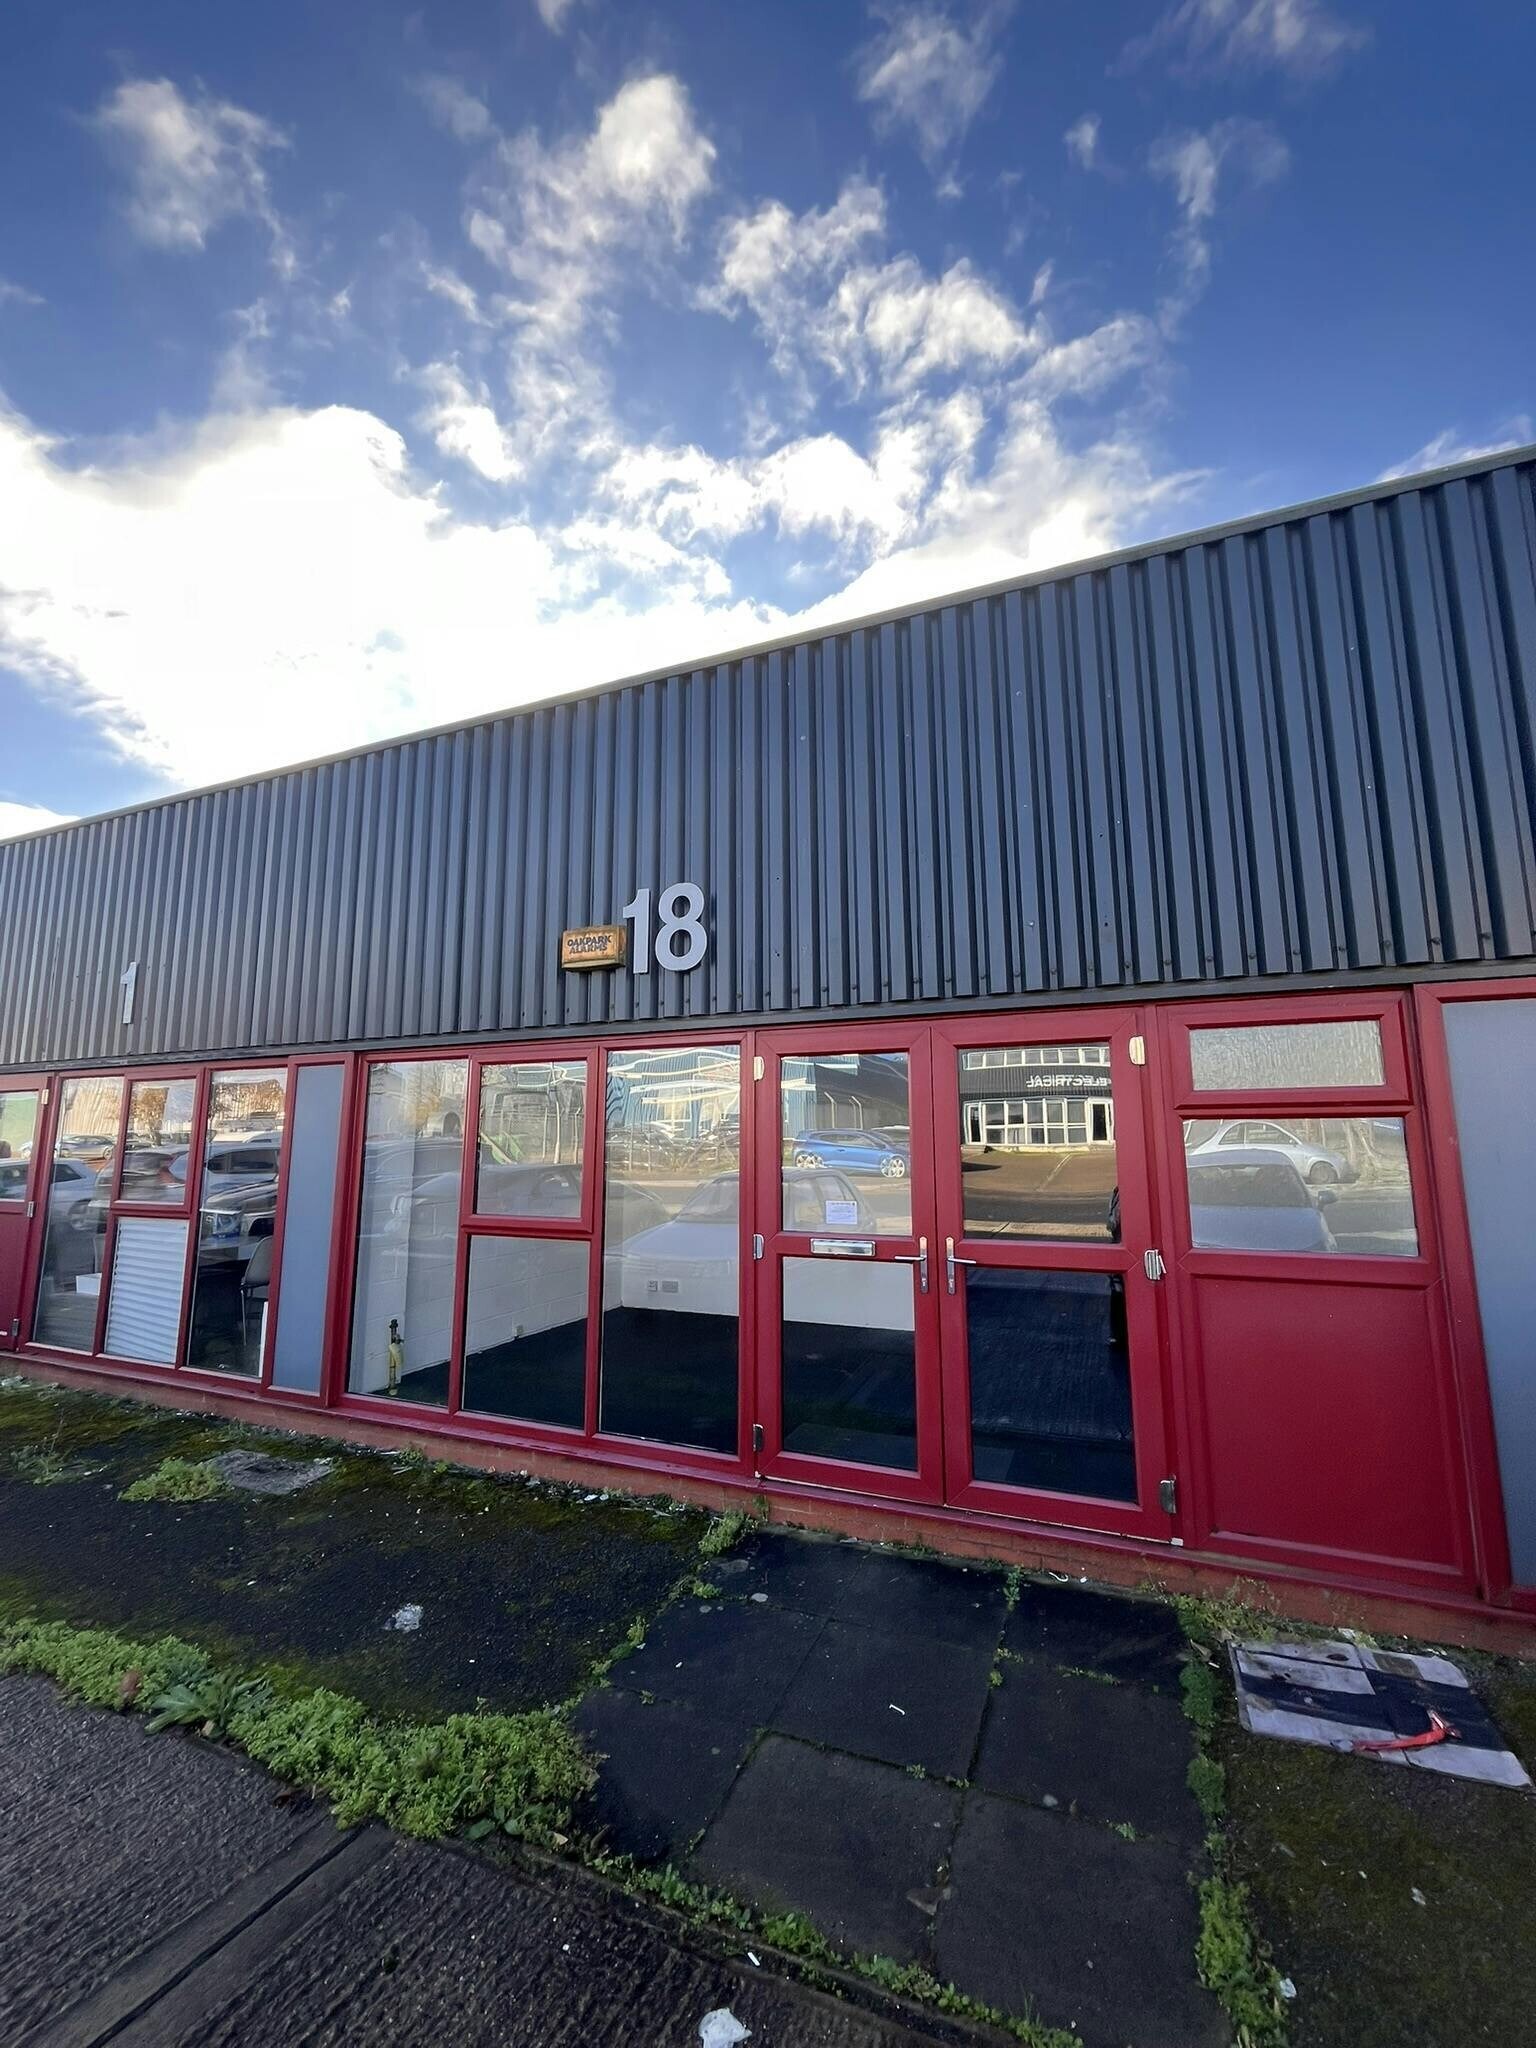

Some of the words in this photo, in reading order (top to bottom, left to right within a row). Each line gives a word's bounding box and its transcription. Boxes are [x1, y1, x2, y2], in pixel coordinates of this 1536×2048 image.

[567, 935, 612, 947] OAKPARK
[623, 882, 708, 974] 18
[569, 943, 608, 954] ALARMS
[120, 961, 137, 1024] 1
